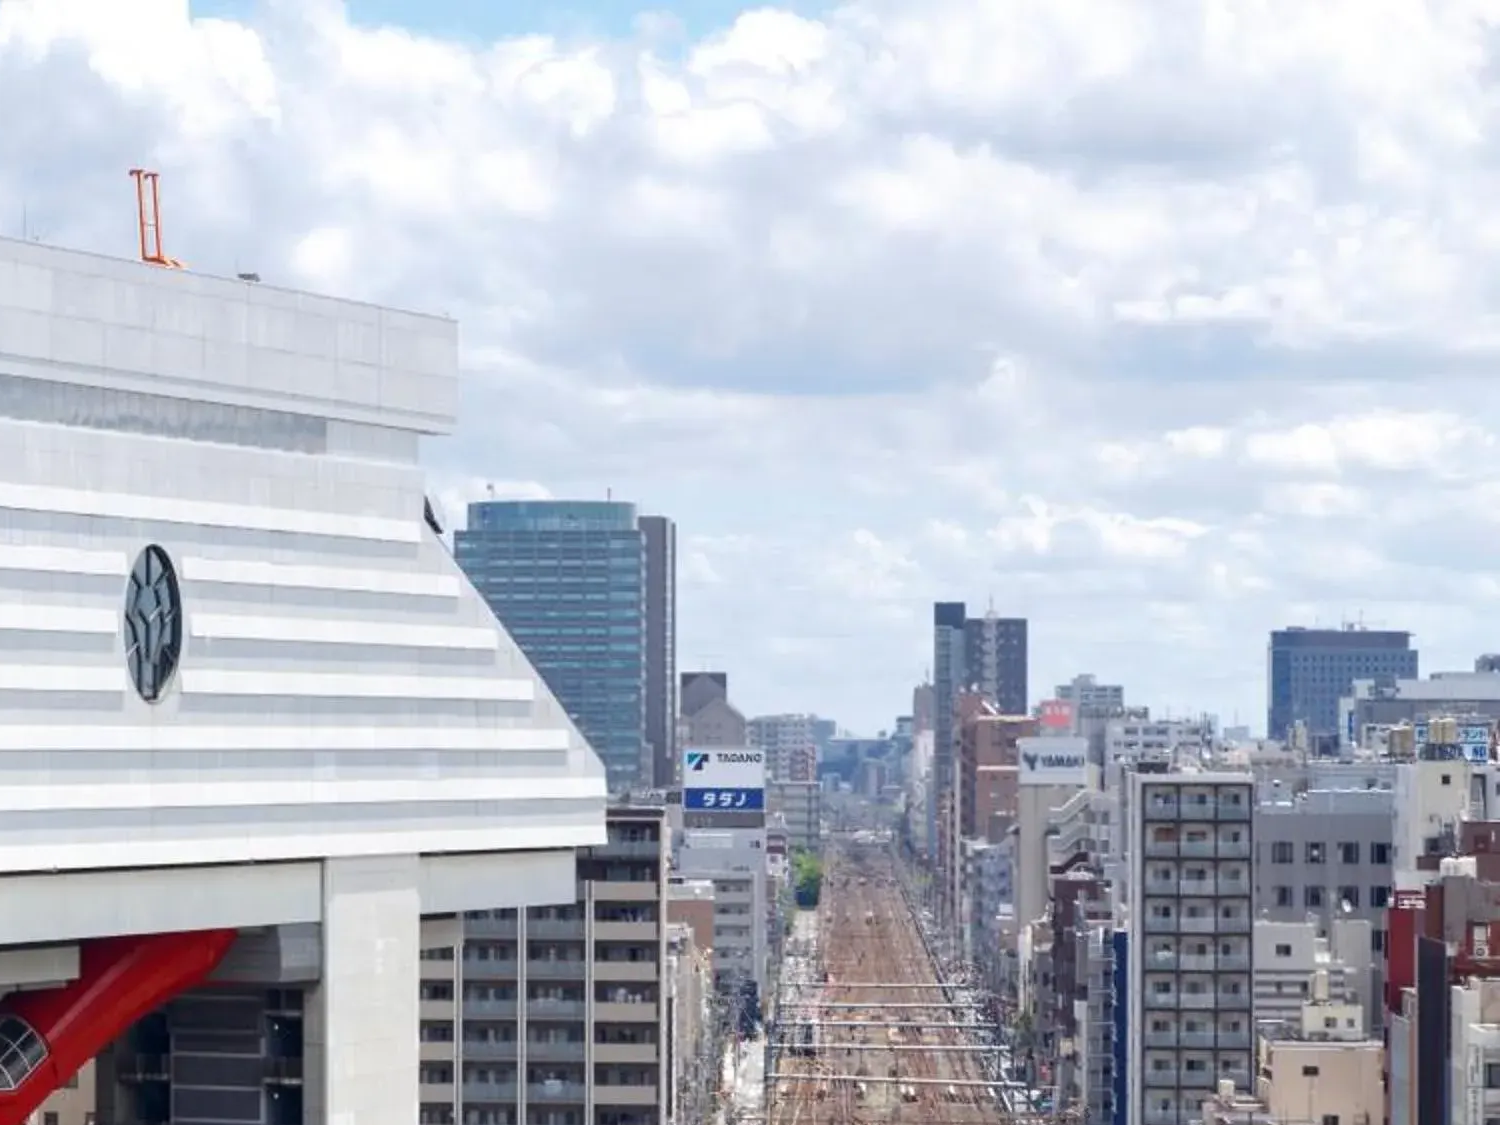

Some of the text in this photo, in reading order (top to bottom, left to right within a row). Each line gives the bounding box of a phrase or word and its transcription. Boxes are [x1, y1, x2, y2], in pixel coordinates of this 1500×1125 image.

[716, 753, 763, 763] TADANO
[703, 792, 747, 807] タダノ
